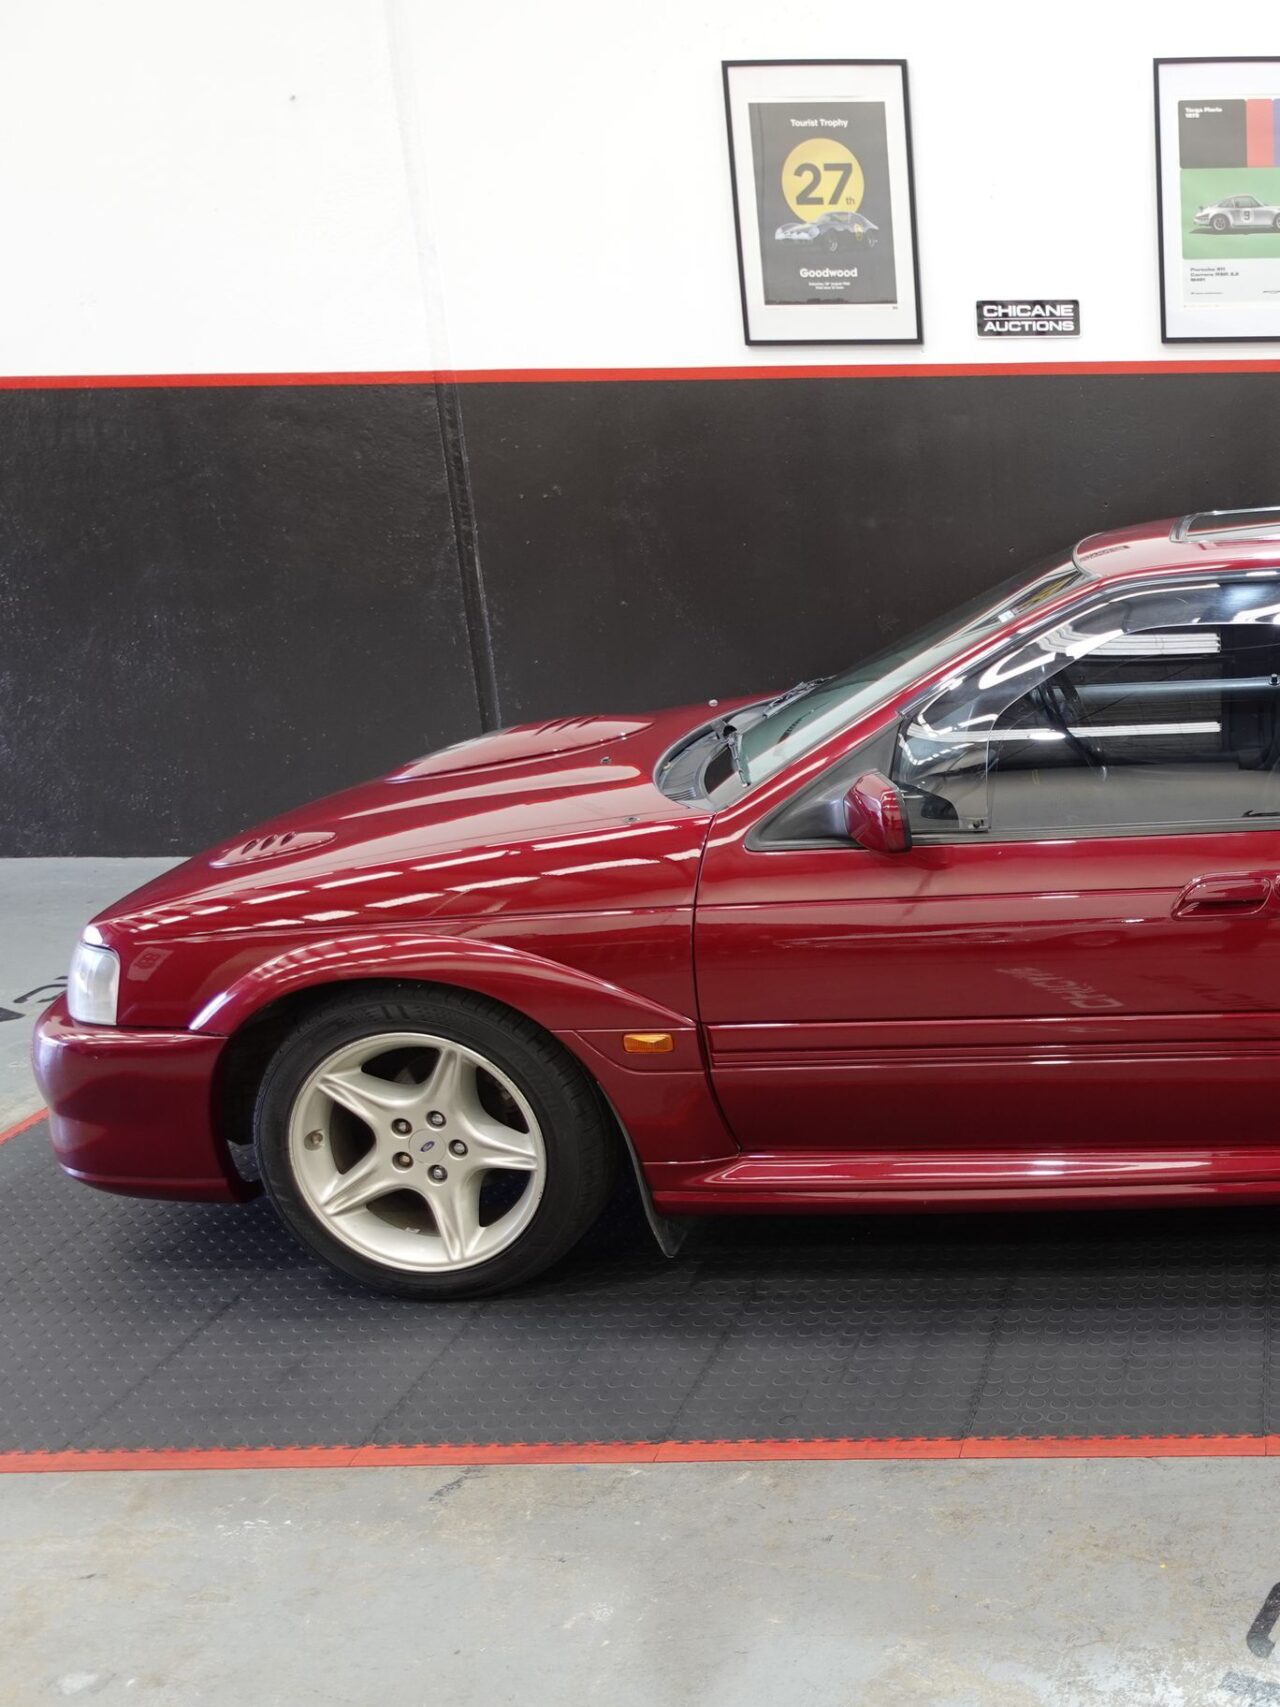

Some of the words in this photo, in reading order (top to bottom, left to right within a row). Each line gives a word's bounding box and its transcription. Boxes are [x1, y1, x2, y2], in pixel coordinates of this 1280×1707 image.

[790, 119, 818, 127] Tourist
[820, 118, 848, 128] Trophy
[799, 267, 858, 278] Goodwood
[983, 304, 1075, 317] CHICANE
[984, 321, 1075, 332] AUCTIONS
